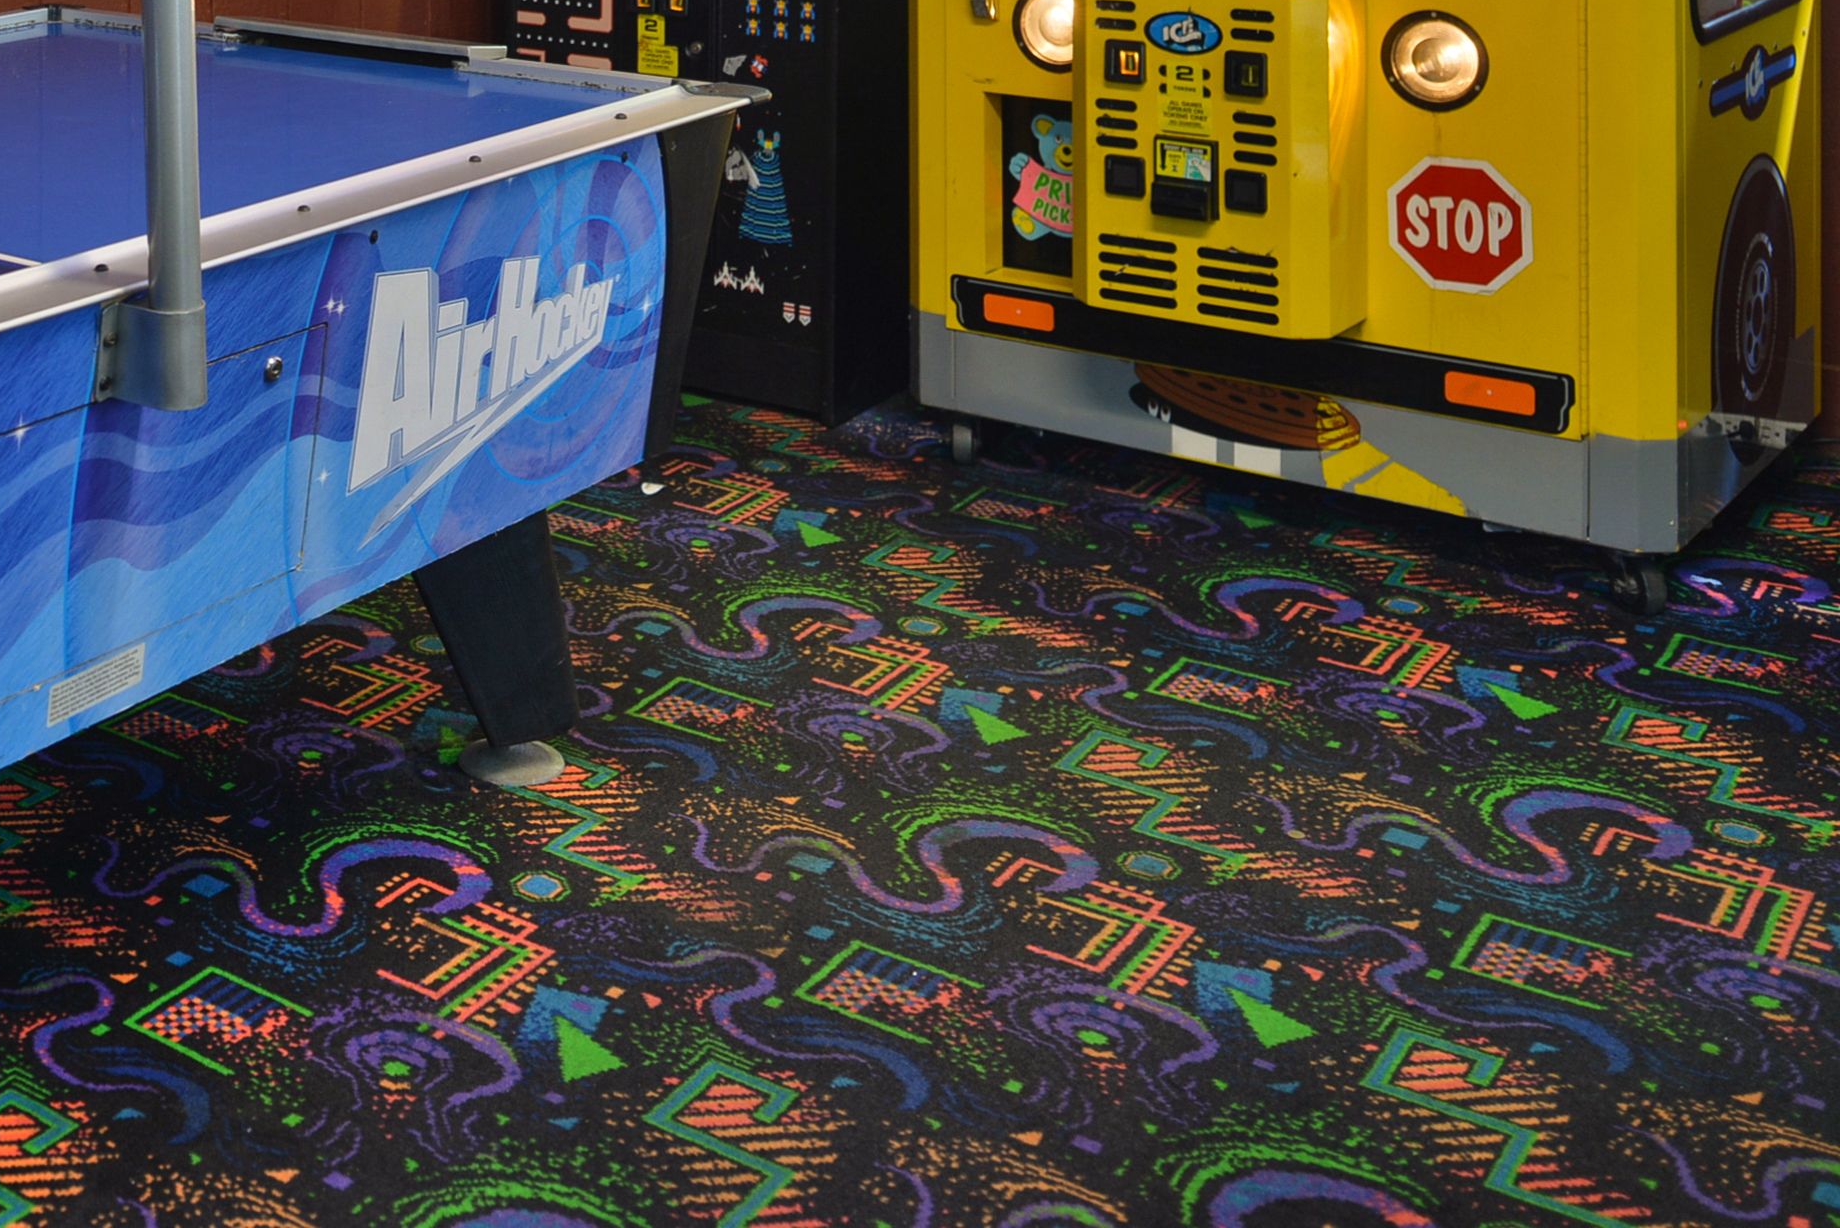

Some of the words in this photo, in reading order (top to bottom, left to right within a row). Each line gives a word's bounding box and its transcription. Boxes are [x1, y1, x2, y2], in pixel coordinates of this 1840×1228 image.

[645, 19, 658, 32] 2
[1175, 66, 1194, 82] 2
[1033, 172, 1072, 205] PRI
[1031, 197, 1072, 224] PICK
[1405, 193, 1513, 257] STOP
